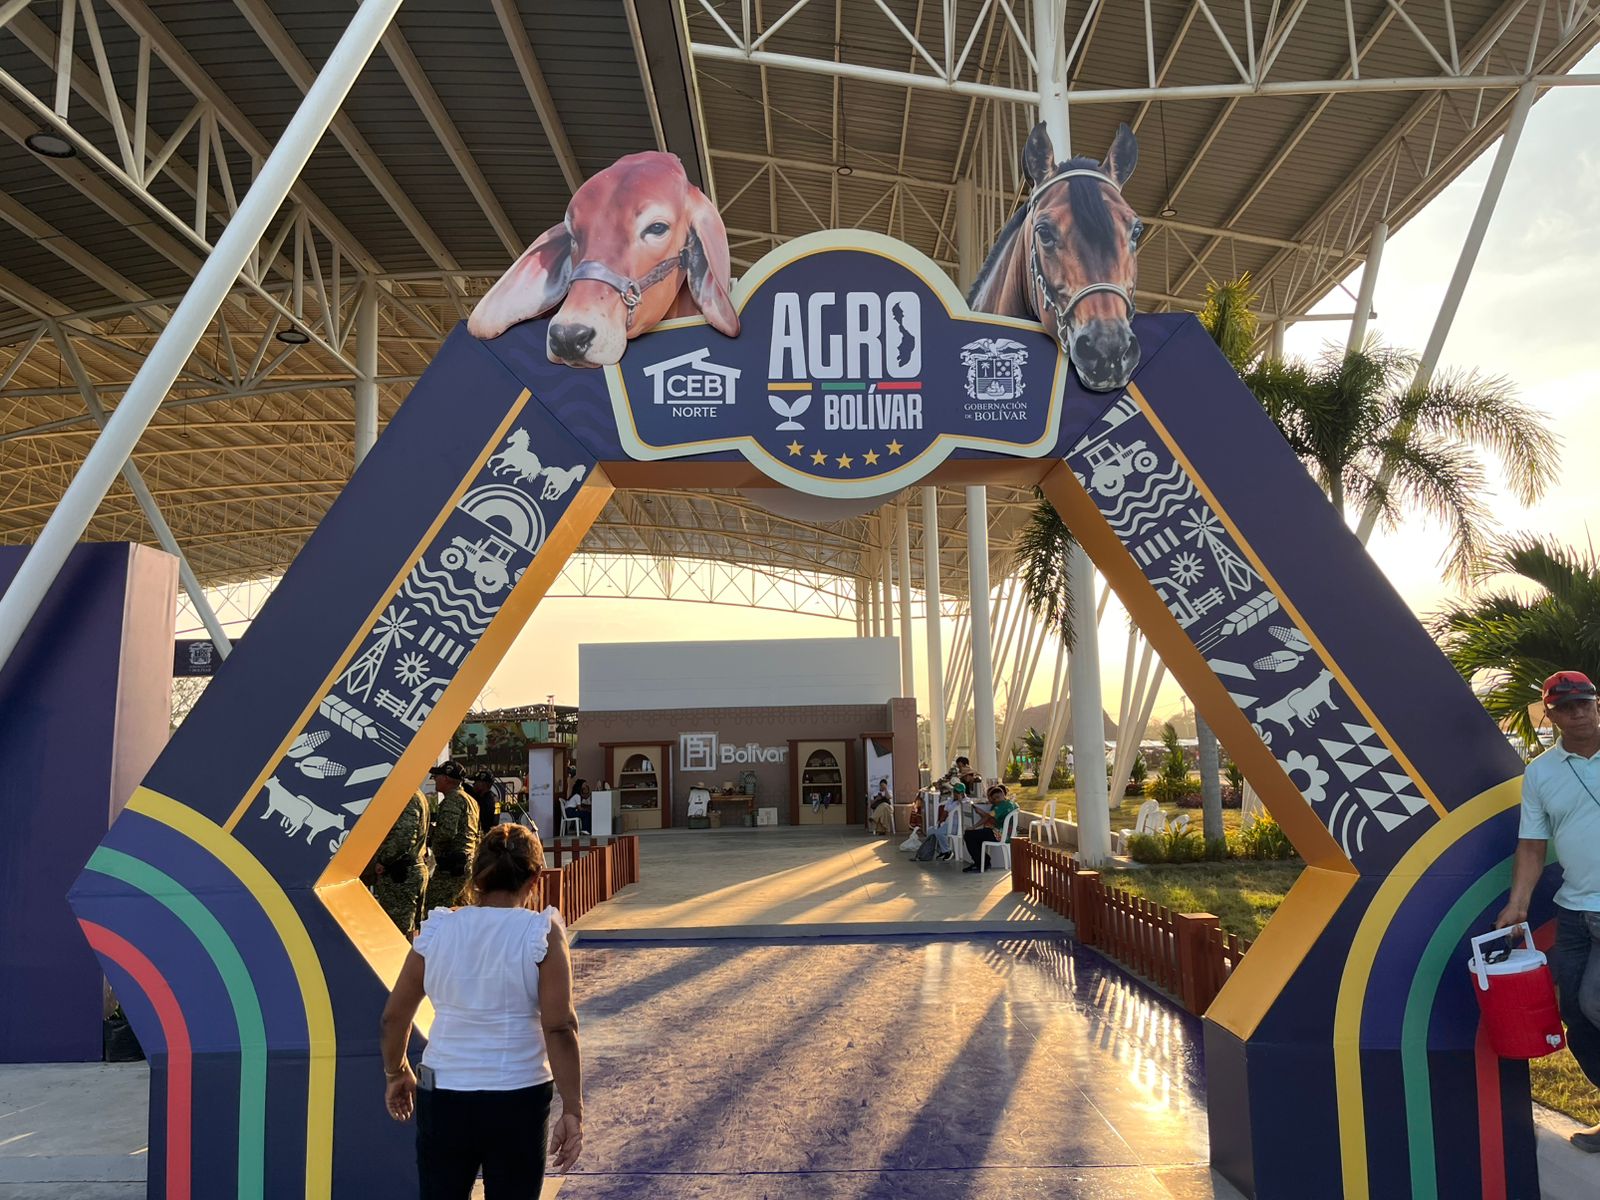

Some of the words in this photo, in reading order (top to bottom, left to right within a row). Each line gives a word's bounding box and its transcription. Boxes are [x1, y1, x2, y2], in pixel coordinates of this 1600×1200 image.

[768, 291, 922, 379] AGRO
[666, 374, 723, 397] CEB
[672, 406, 717, 418] NORTE
[824, 384, 923, 430] BOLÍVAR
[963, 401, 1028, 411] GOBERNACIÓN
[974, 409, 1028, 421] BOLÍVAR
